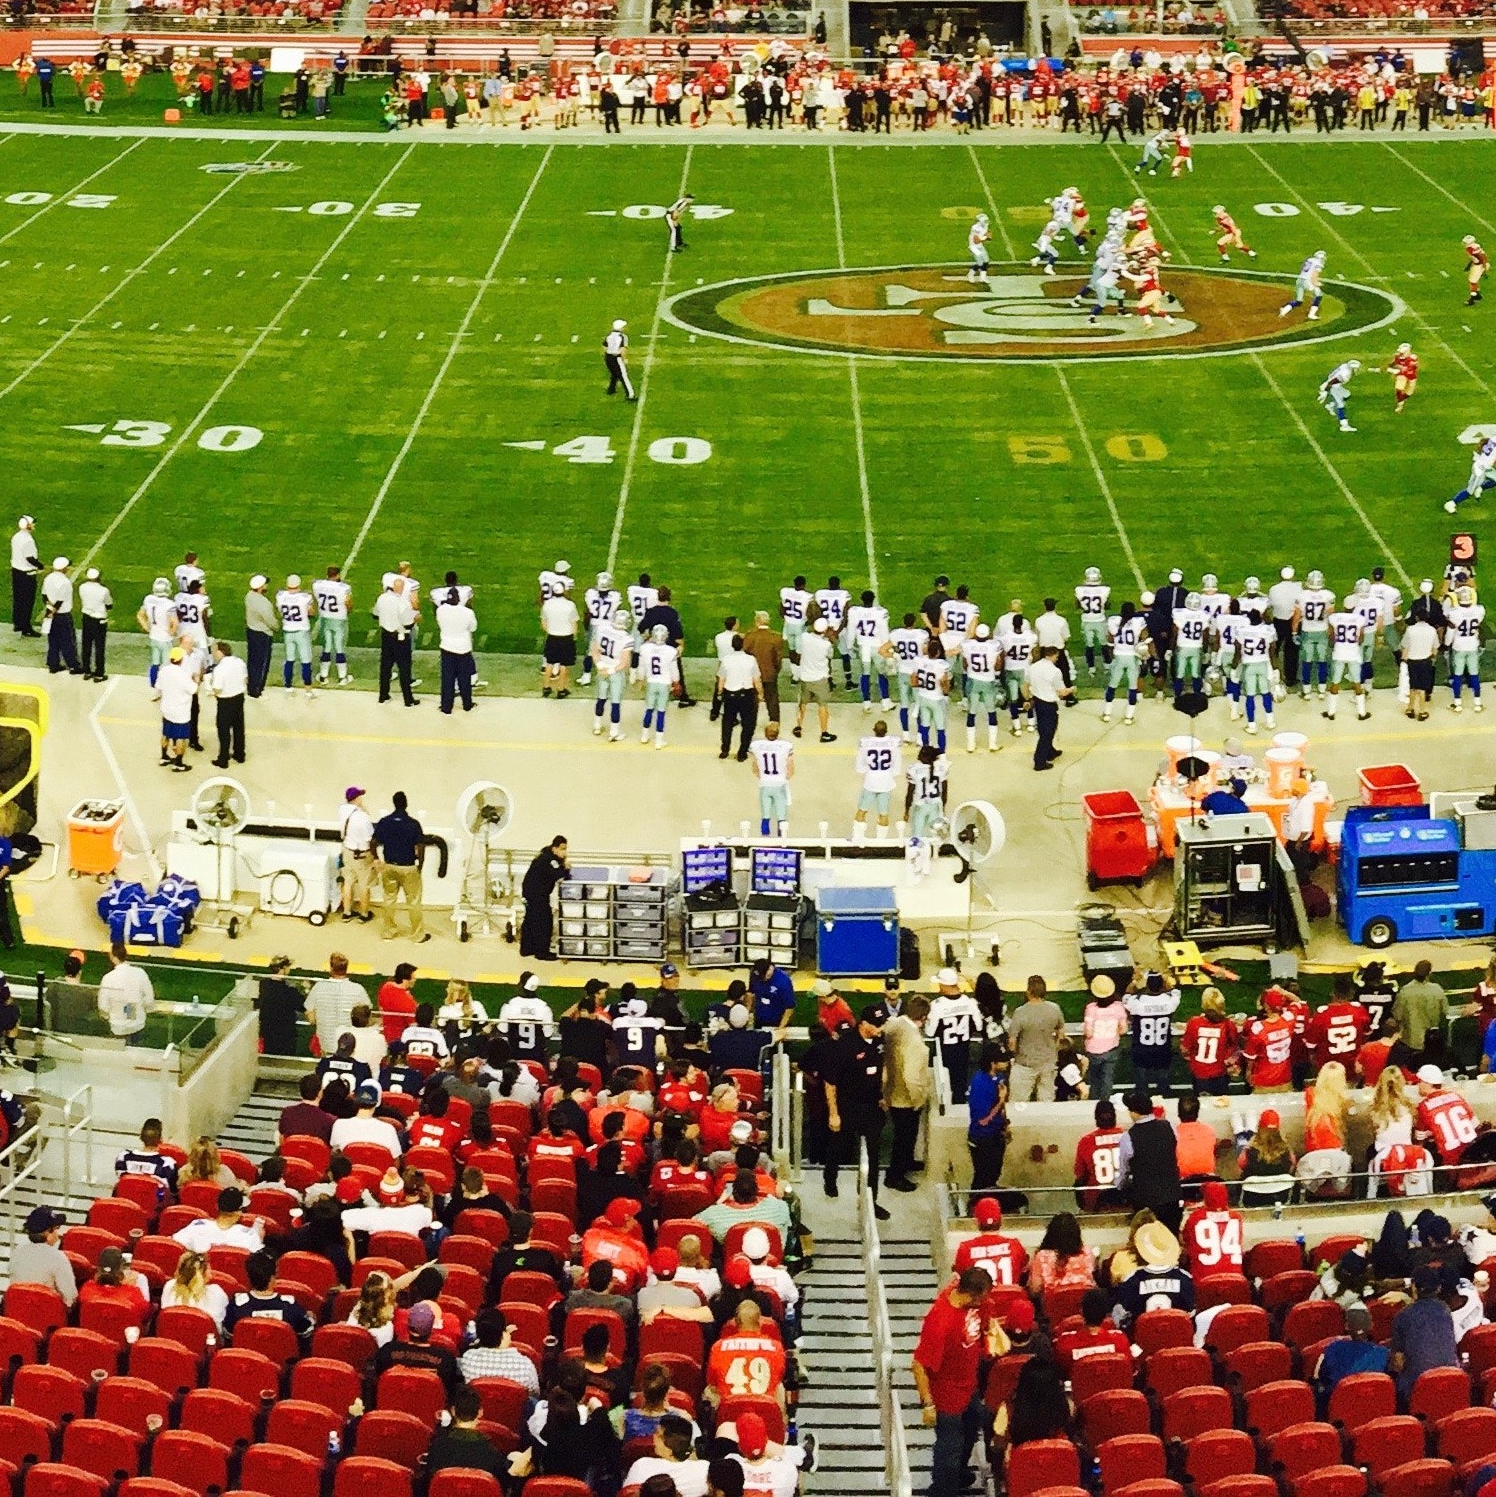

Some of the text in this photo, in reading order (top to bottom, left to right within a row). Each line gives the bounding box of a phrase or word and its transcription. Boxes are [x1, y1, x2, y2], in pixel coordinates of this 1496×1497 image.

[100, 420, 265, 454] 30
[550, 434, 714, 466] 40
[1007, 433, 1169, 466] 50
[1452, 534, 1475, 559] 3
[281, 605, 303, 622] 22
[318, 593, 339, 613] 72
[591, 599, 612, 620] 37
[633, 596, 648, 617] 21
[784, 598, 803, 620] 25
[820, 599, 842, 620] 24
[1081, 596, 1102, 614] 33
[1304, 601, 1326, 621] 87
[151, 605, 157, 625] 1
[179, 604, 199, 624] 23
[946, 611, 966, 631] 52
[856, 619, 876, 638] 47
[1181, 621, 1202, 641] 48
[1335, 625, 1358, 644] 83
[1007, 644, 1029, 661] 45
[1243, 638, 1266, 656] 54
[651, 656, 662, 676] 6
[971, 653, 989, 673] 51
[762, 752, 778, 775] 11
[867, 749, 892, 771] 32
[921, 776, 941, 799] 13
[1368, 1004, 1383, 1030] 7
[518, 1025, 537, 1050] 9
[627, 1026, 644, 1052] 9
[943, 1015, 971, 1045] 24
[1139, 1016, 1170, 1046] 88
[1328, 1024, 1358, 1054] 52
[1195, 1036, 1219, 1064] 11
[1434, 1105, 1477, 1152] 16
[1194, 1217, 1243, 1266] 94
[720, 1337, 777, 1353] FAITHFUL
[724, 1356, 772, 1395] 49
